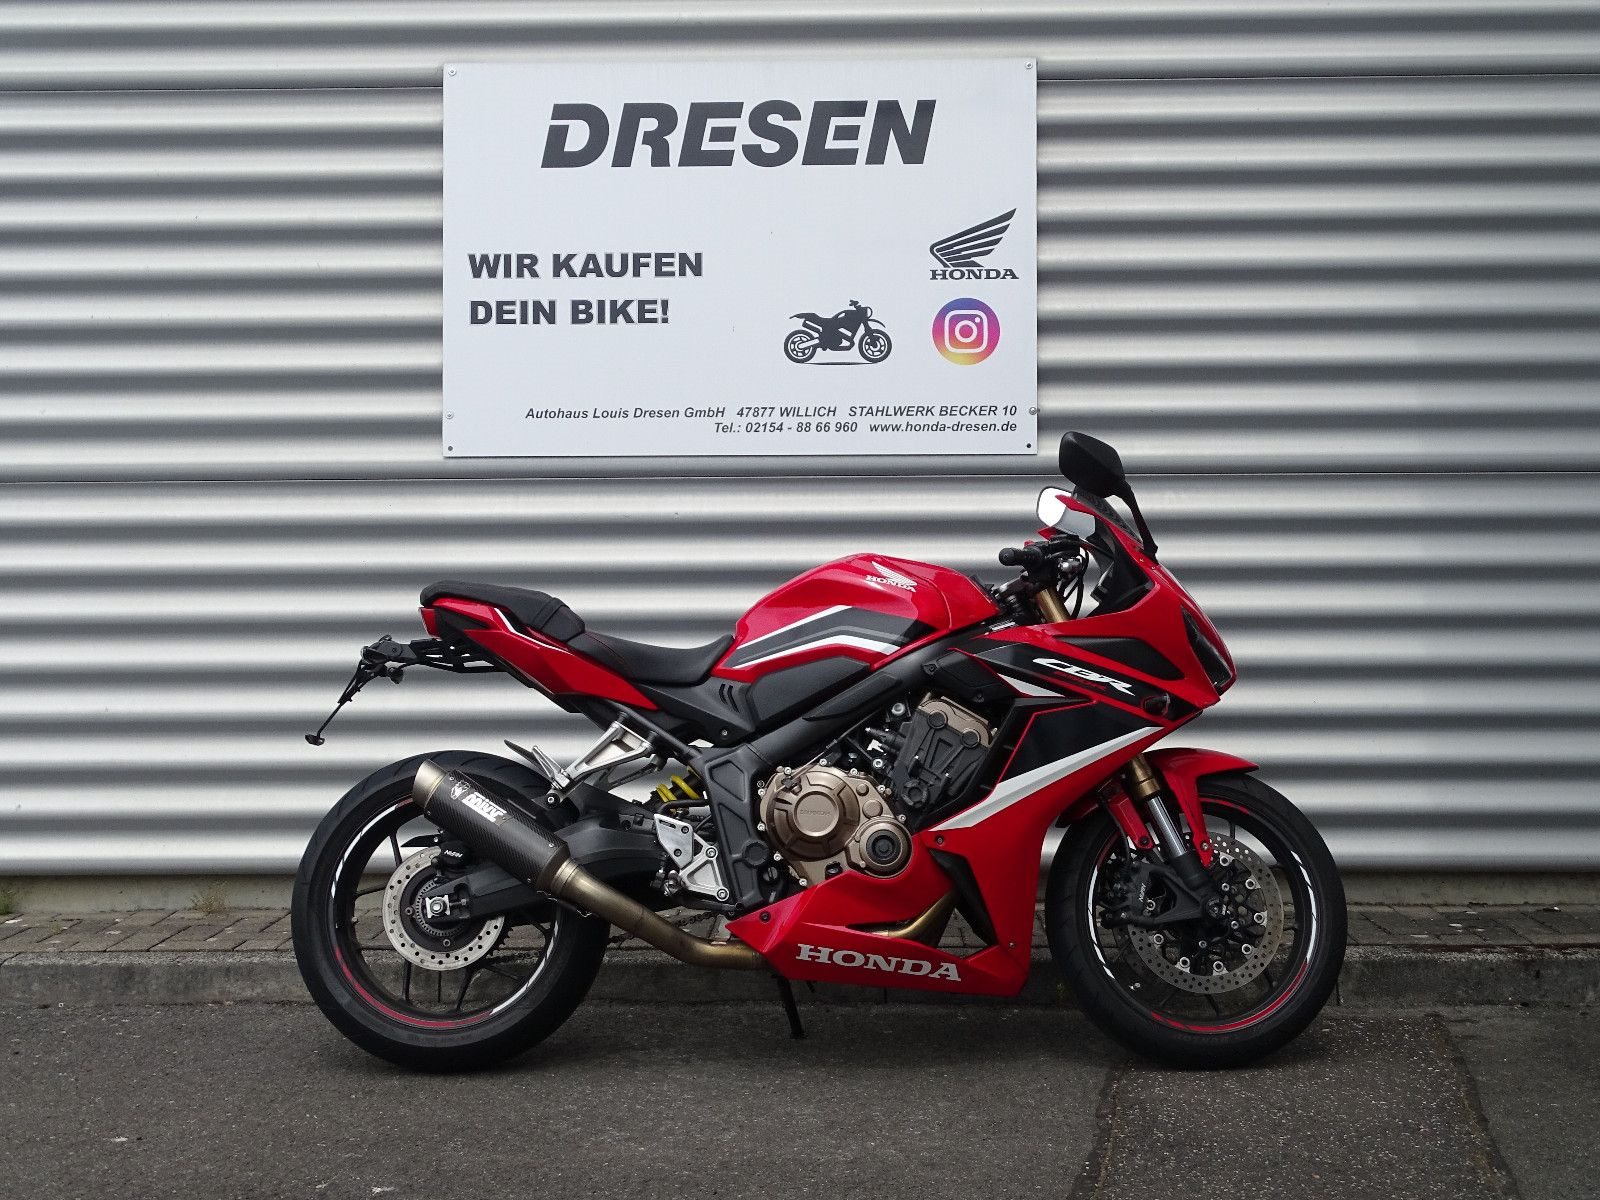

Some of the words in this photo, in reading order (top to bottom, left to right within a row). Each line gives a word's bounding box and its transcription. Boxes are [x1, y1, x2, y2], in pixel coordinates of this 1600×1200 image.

[541, 99, 936, 168] DRESEN
[468, 253, 540, 279] WIR
[552, 252, 703, 278] KAUFEN
[929, 268, 1020, 281] HONDA
[470, 300, 556, 325] DEIN
[570, 299, 669, 325] BIKE!
[525, 407, 589, 419] Autohaus
[592, 407, 630, 419] Louis
[633, 407, 680, 419] Dresen
[684, 406, 726, 418] GmbH
[736, 406, 776, 418] 47877
[779, 406, 837, 418] WILLICH
[848, 405, 935, 417] STAHLWERK
[938, 405, 998, 417] BECKER
[1002, 405, 1017, 416] 10
[714, 422, 741, 433] Tel.:
[745, 421, 784, 433] 02154
[796, 421, 812, 433] 88
[815, 421, 831, 433] 66
[834, 421, 858, 433] 960
[869, 420, 1017, 432] www.honda-dresen.de
[865, 575, 917, 592] HONDA
[1032, 658, 1136, 696] CBR
[795, 943, 962, 982] HONDA
